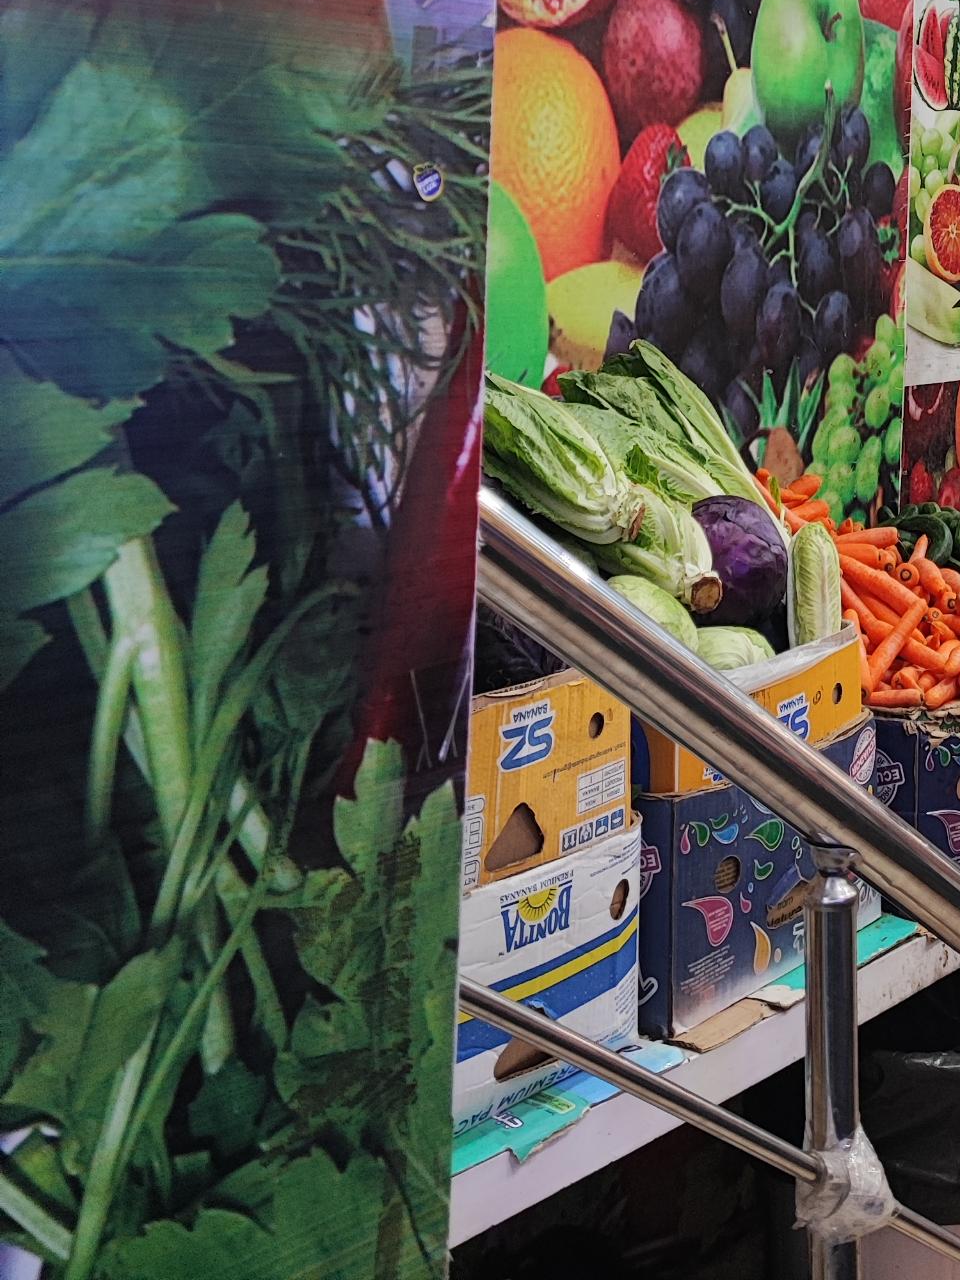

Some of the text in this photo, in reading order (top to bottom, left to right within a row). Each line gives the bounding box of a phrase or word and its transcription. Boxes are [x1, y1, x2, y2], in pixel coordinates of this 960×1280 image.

[513, 702, 549, 724] BANANA
[779, 694, 804, 714] BANANA
[500, 717, 553, 770] SZ
[499, 870, 575, 903] PREMIUM BANANAS
[500, 885, 573, 953] BONITA
